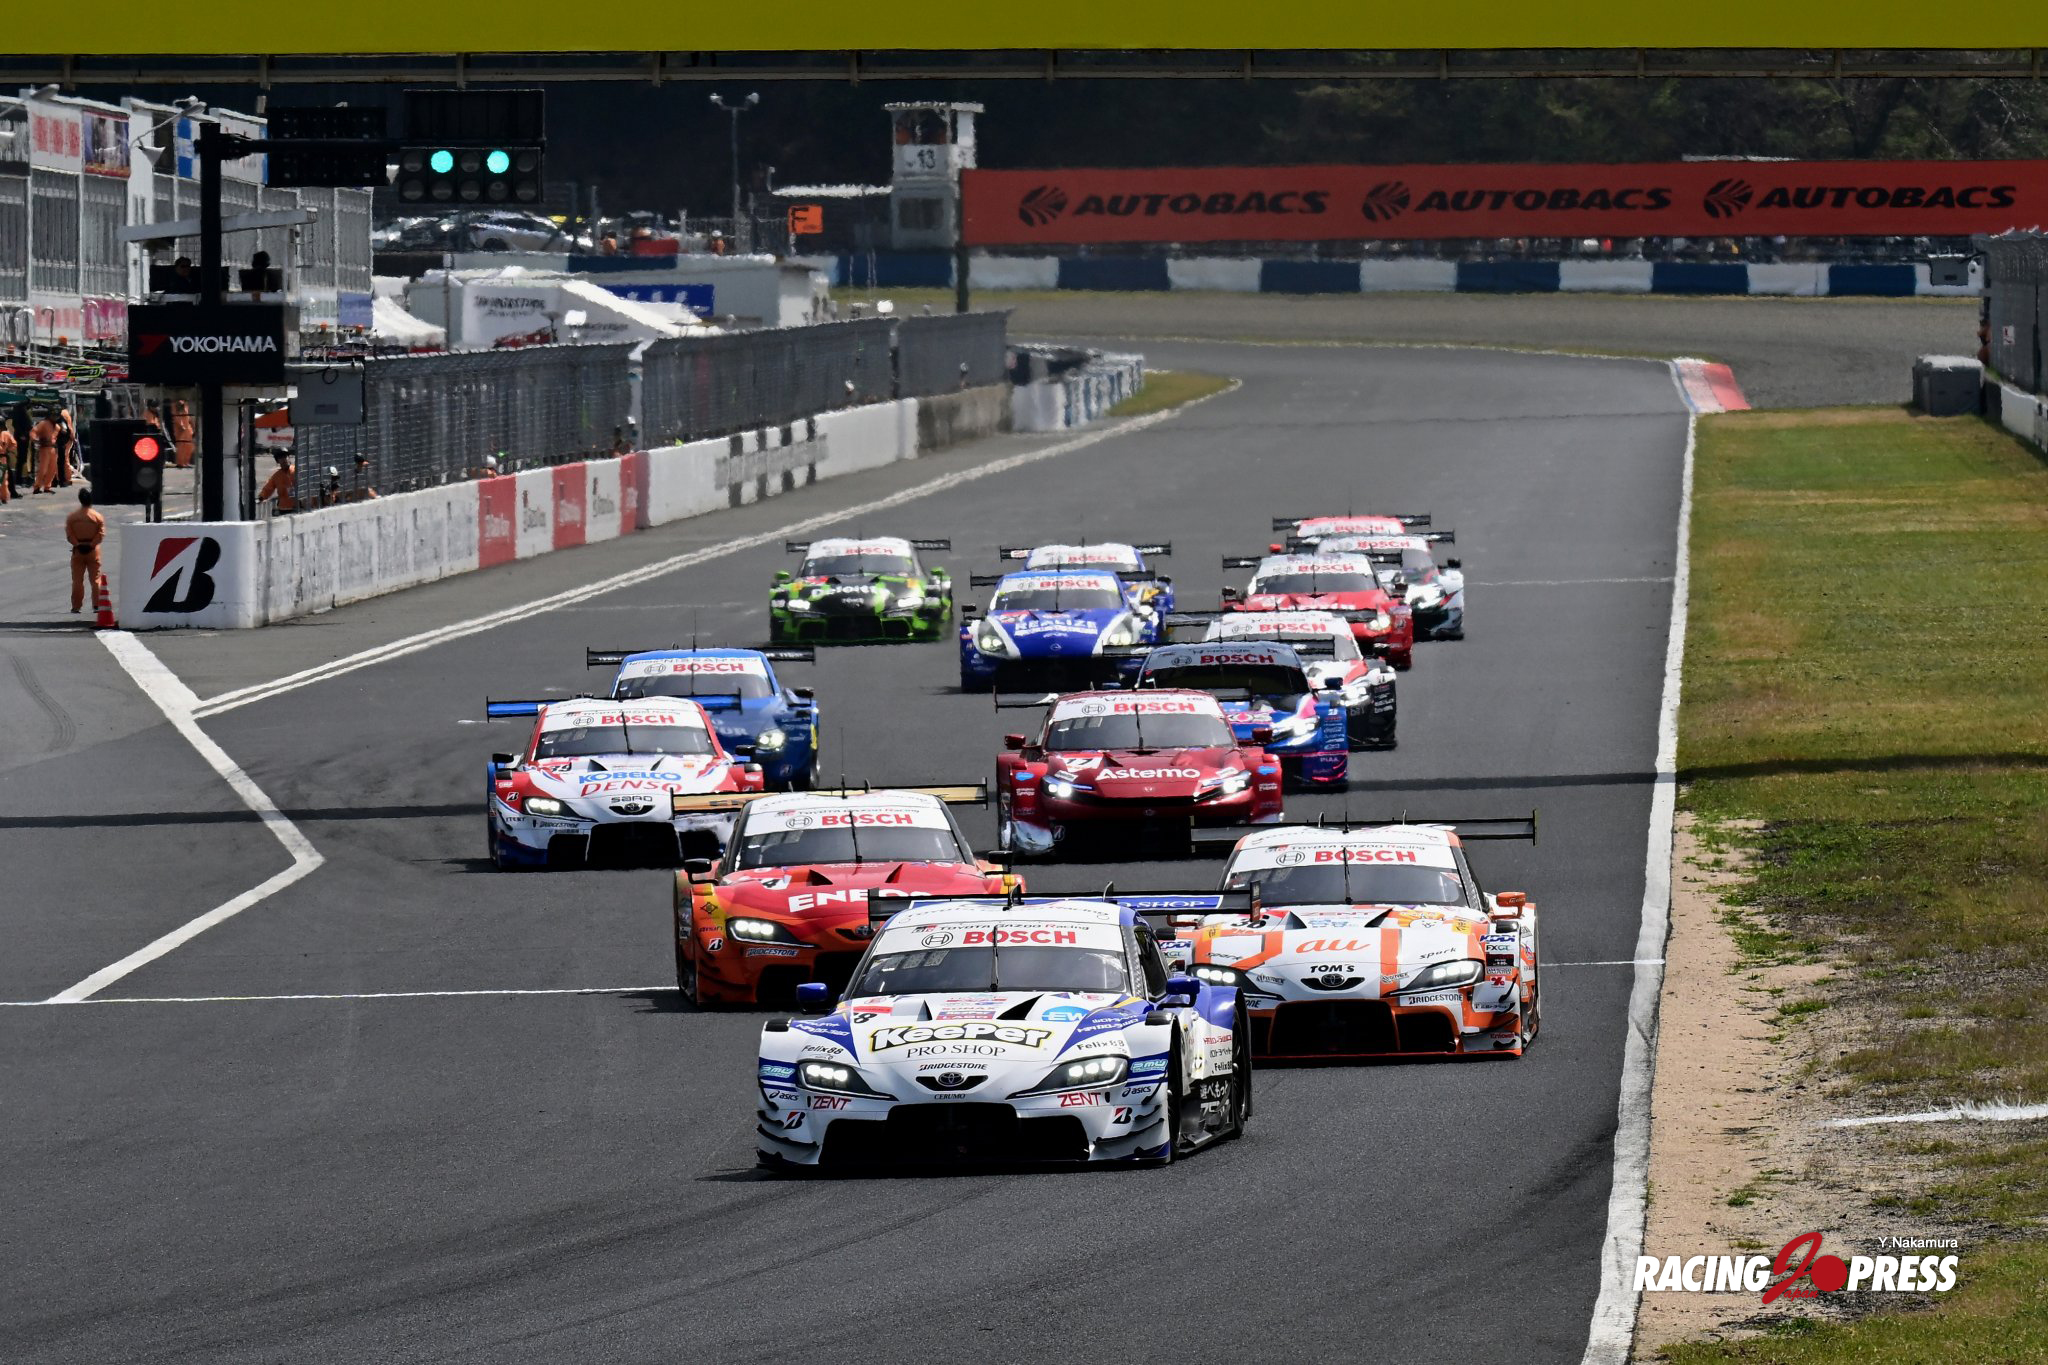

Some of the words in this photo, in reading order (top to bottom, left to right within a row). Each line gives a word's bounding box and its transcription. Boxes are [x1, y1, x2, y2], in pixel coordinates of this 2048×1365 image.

[1072, 191, 1330, 216] AUTOBACS
[1414, 188, 1672, 212] AUTOBACS
[1755, 186, 2018, 209] AUTOBACS
[169, 335, 278, 354] YOKOHAMA
[1357, 540, 1412, 549] BOSCH
[1298, 564, 1355, 572] BOSCH
[1039, 579, 1100, 588] BOSCH
[1259, 623, 1327, 633] BOSCH
[1200, 654, 1274, 665] BOSCH
[673, 663, 745, 673] BOSCH
[1113, 702, 1196, 713] BOSCH
[601, 715, 676, 725] BOSCH
[579, 771, 682, 784] KOBELCO
[1096, 768, 1200, 780] Astemo
[581, 780, 683, 797] DENSO
[821, 814, 913, 826] BOSCH
[1315, 850, 1417, 863] BOSCH
[1044, 923, 1090, 931] Racing
[963, 930, 1077, 945] BOSCH
[1296, 939, 1371, 953] au
[746, 948, 799, 957] BRIDGESTONE
[1408, 993, 1463, 1005] BRIDGESTONE
[872, 1022, 1053, 1052] KeePer
[907, 1045, 947, 1058] PRO
[951, 1044, 1006, 1057] SHOP
[919, 1062, 988, 1071] BRIDGESTONE
[779, 1092, 800, 1101] asics
[1131, 1086, 1151, 1095] asics
[812, 1095, 852, 1110] ZENT
[1057, 1092, 1101, 1107] ZENT
